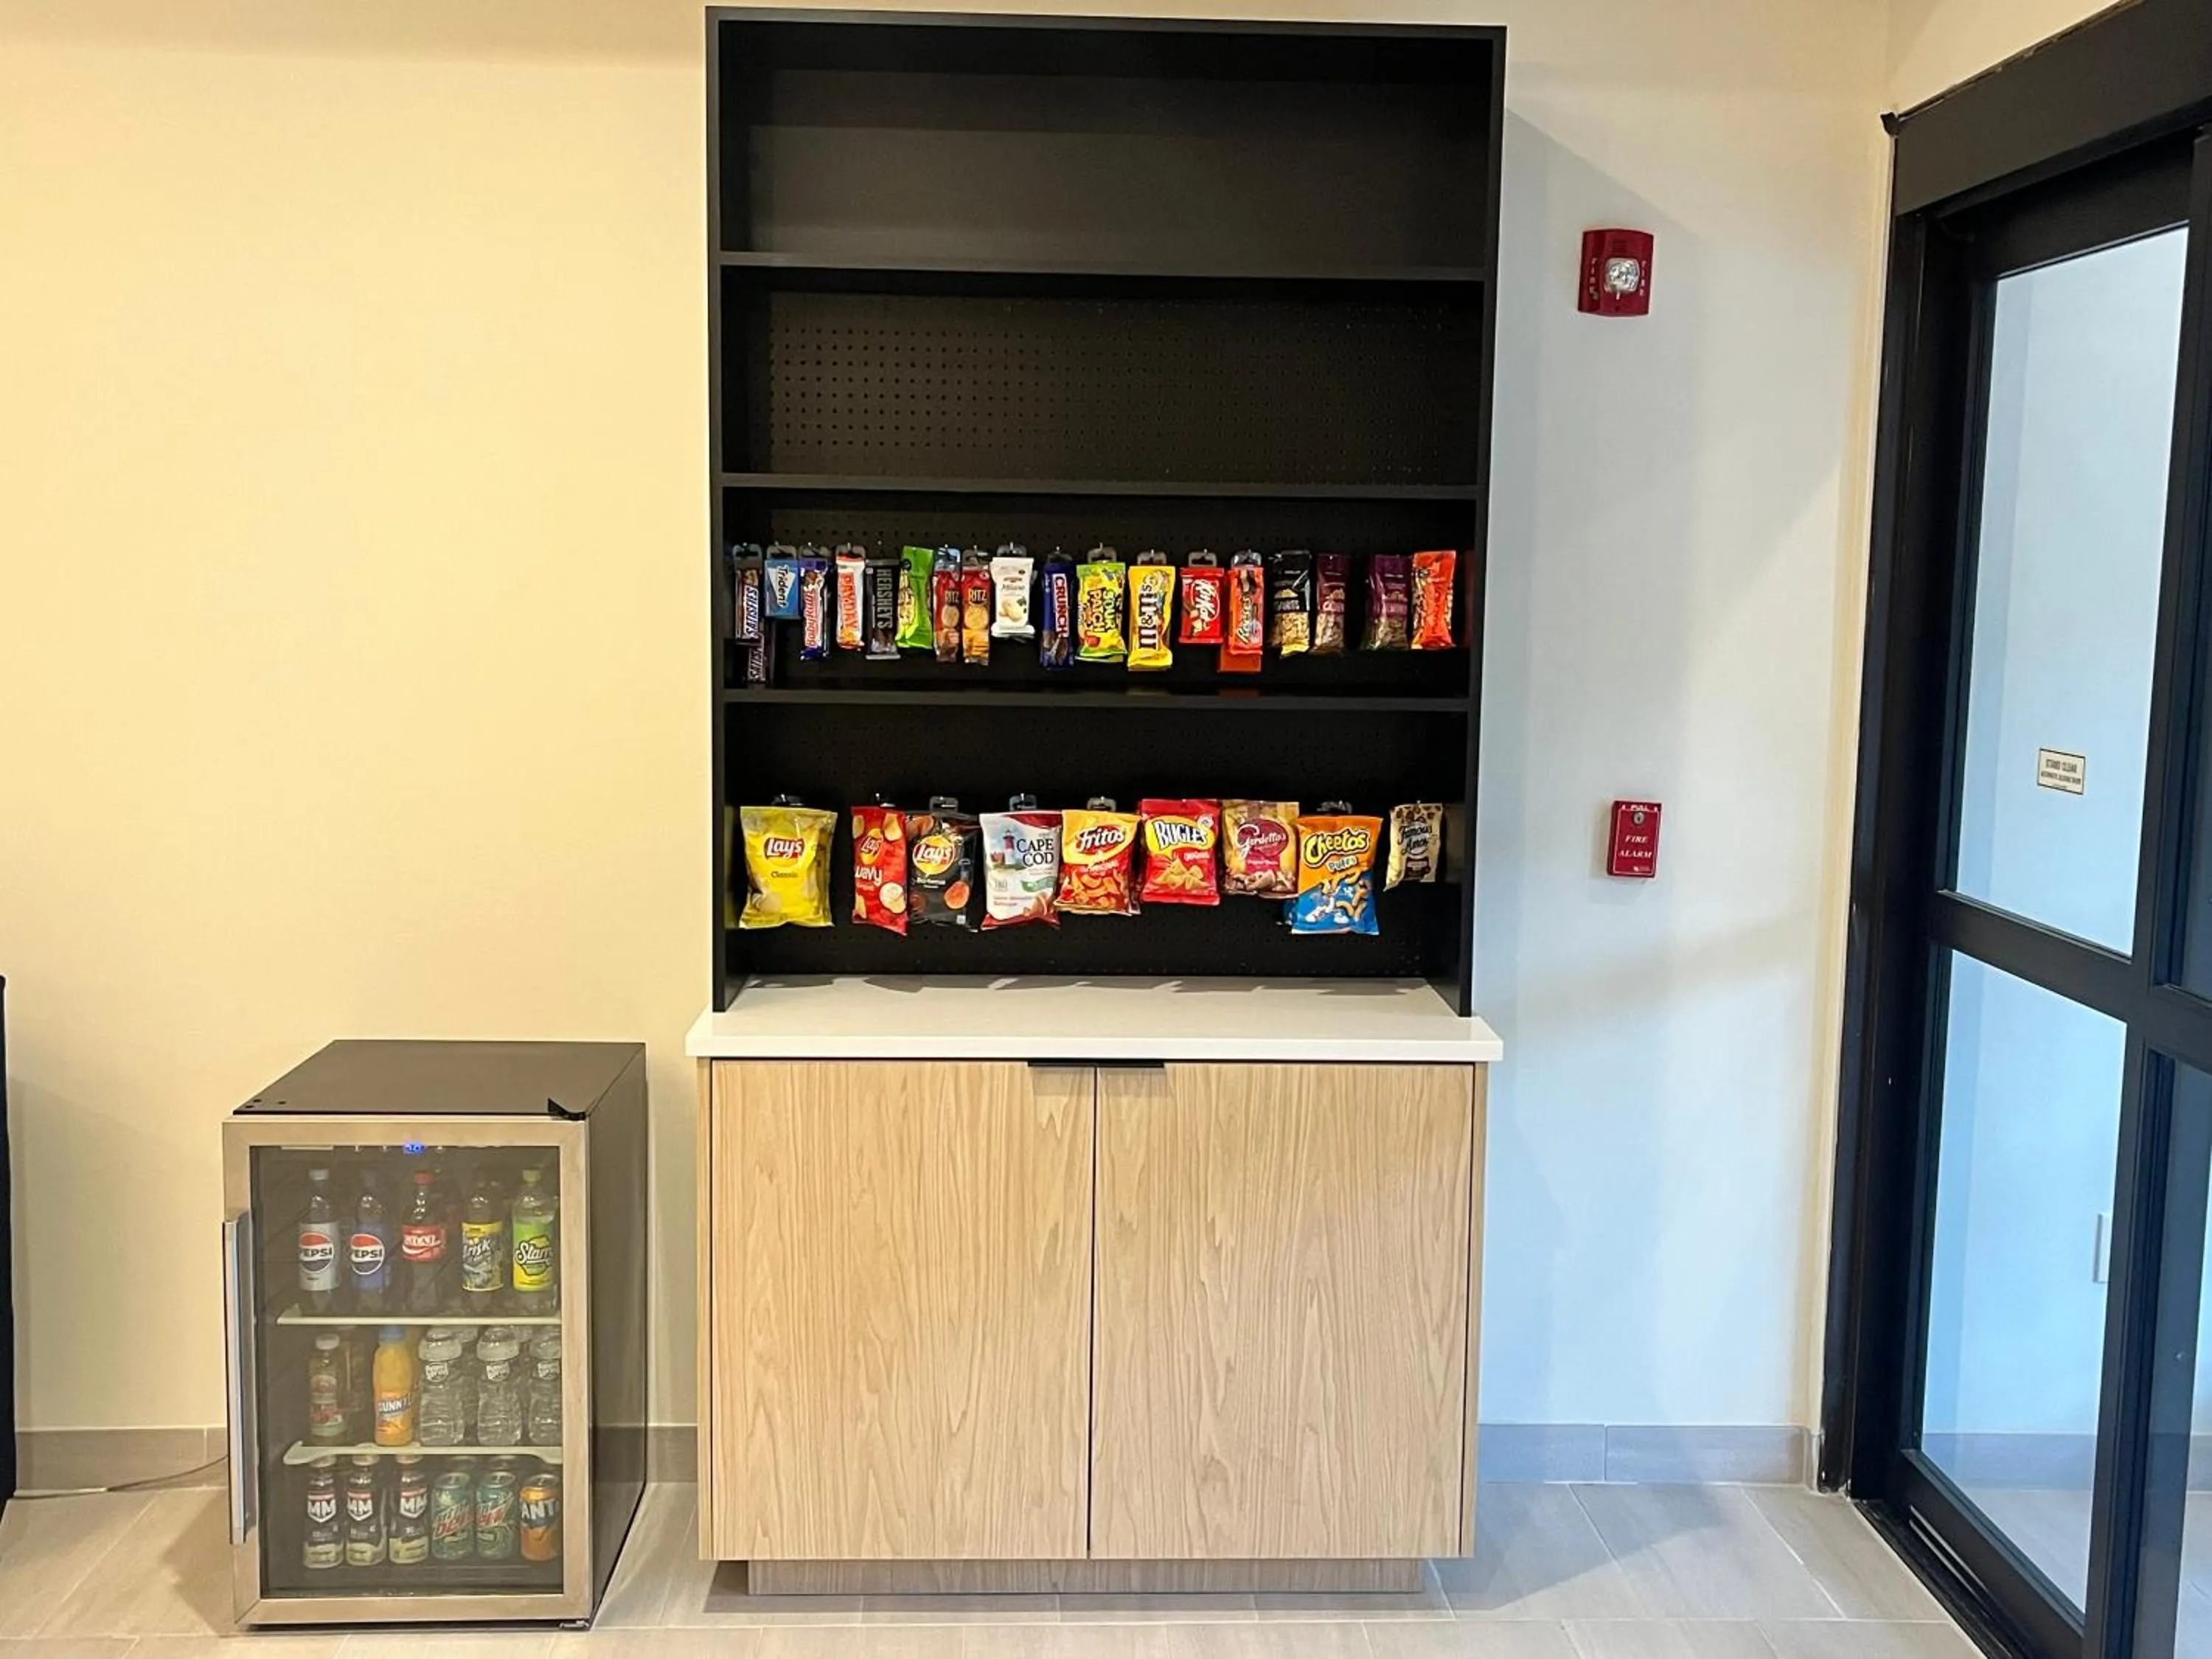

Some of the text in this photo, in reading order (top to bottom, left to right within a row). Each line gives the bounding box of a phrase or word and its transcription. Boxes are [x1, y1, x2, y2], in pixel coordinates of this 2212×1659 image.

[1054, 576, 1068, 636] CRUNCH
[1088, 590, 1105, 632] PATCH
[1103, 590, 1116, 630] SOUR
[1016, 838, 1054, 853] CAPE
[1077, 827, 1125, 852] Fritos
[1154, 820, 1207, 849] BUGLES
[1305, 830, 1367, 864] Cheetos
[1625, 835, 1649, 843] FIRE
[1023, 852, 1054, 866] COD
[520, 1498, 557, 1520] ANT
